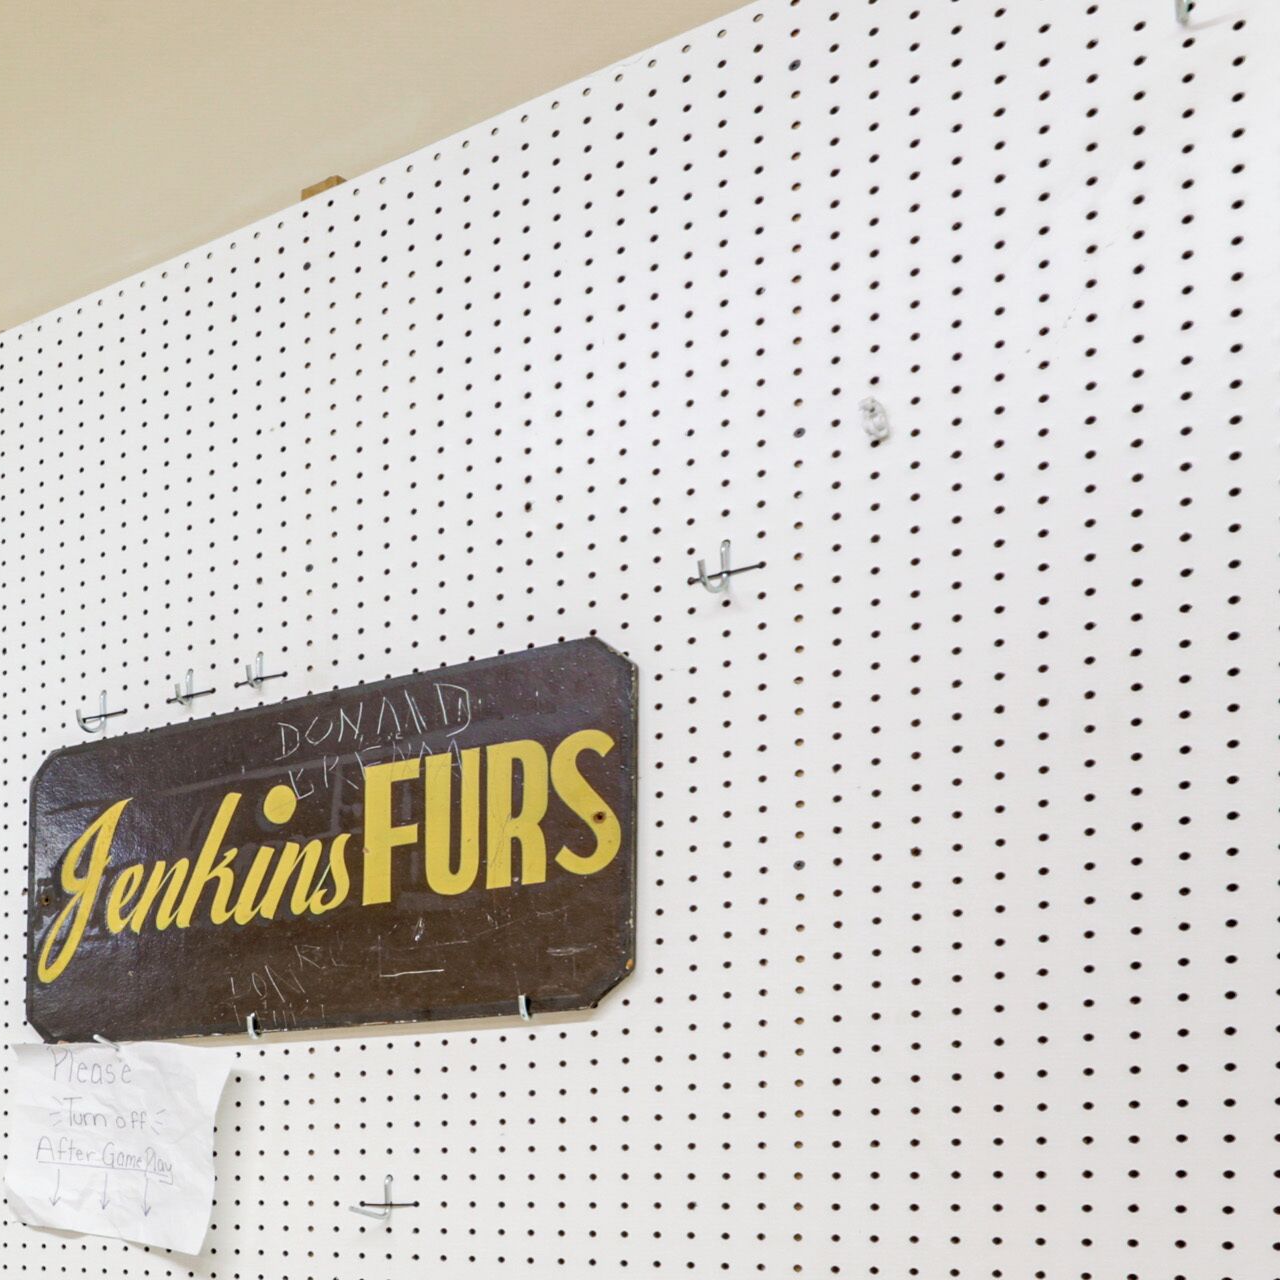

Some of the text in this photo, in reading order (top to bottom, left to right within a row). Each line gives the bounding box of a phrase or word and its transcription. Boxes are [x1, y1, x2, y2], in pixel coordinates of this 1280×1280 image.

[37, 728, 622, 984] Jenkins FURS
[48, 1048, 132, 1085] Please
[63, 1096, 149, 1130] Turn off
[36, 1135, 97, 1162] After
